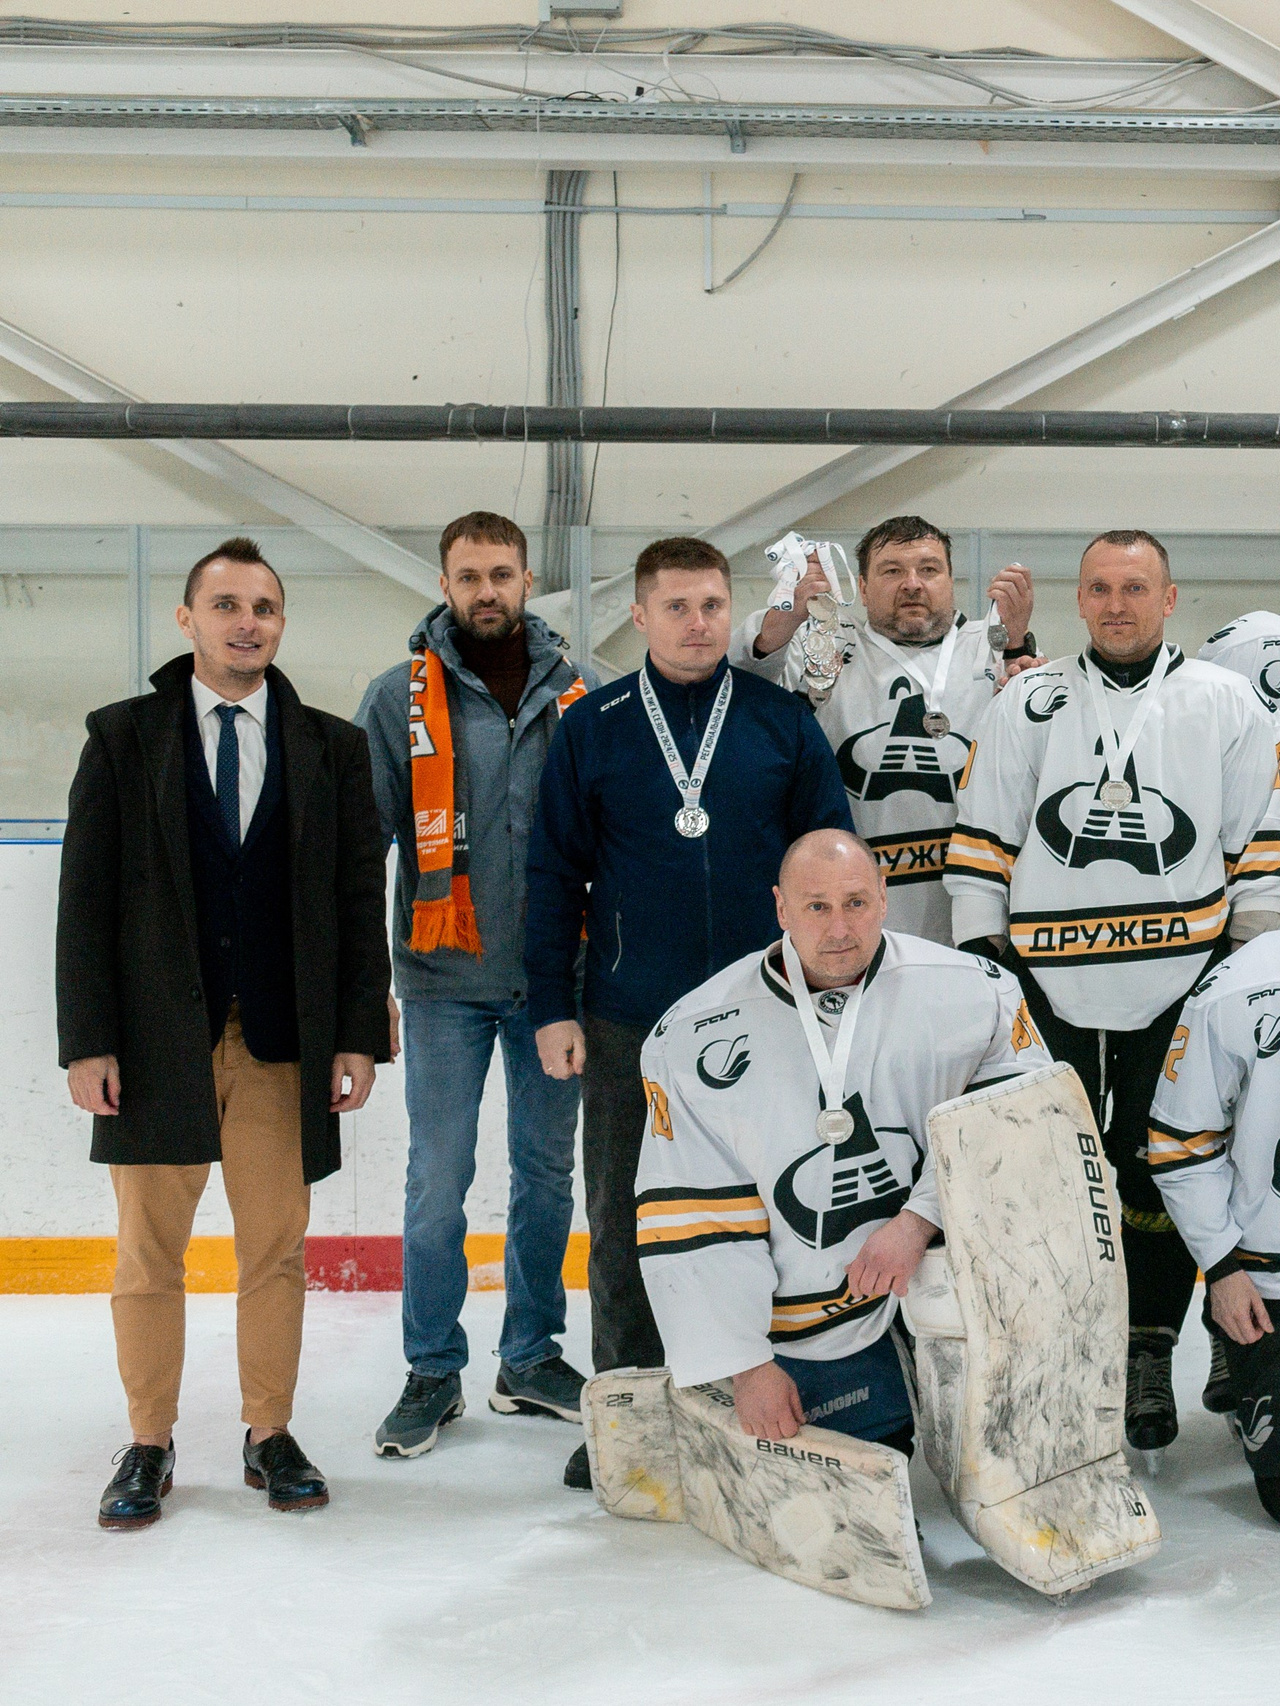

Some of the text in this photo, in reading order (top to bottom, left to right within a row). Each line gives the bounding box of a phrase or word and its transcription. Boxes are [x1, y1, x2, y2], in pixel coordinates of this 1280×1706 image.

[600, 691, 631, 712] CCM
[645, 696, 655, 712] ЛИГА
[652, 713, 665, 735] СЕЗОН
[660, 735, 677, 763] 2024/25
[701, 706, 724, 761] РЕГИОНАЛЬНЫЙ
[1028, 916, 1190, 952] ДРУЖБА
[1161, 1024, 1191, 1085] 2
[606, 1392, 634, 1407] 25
